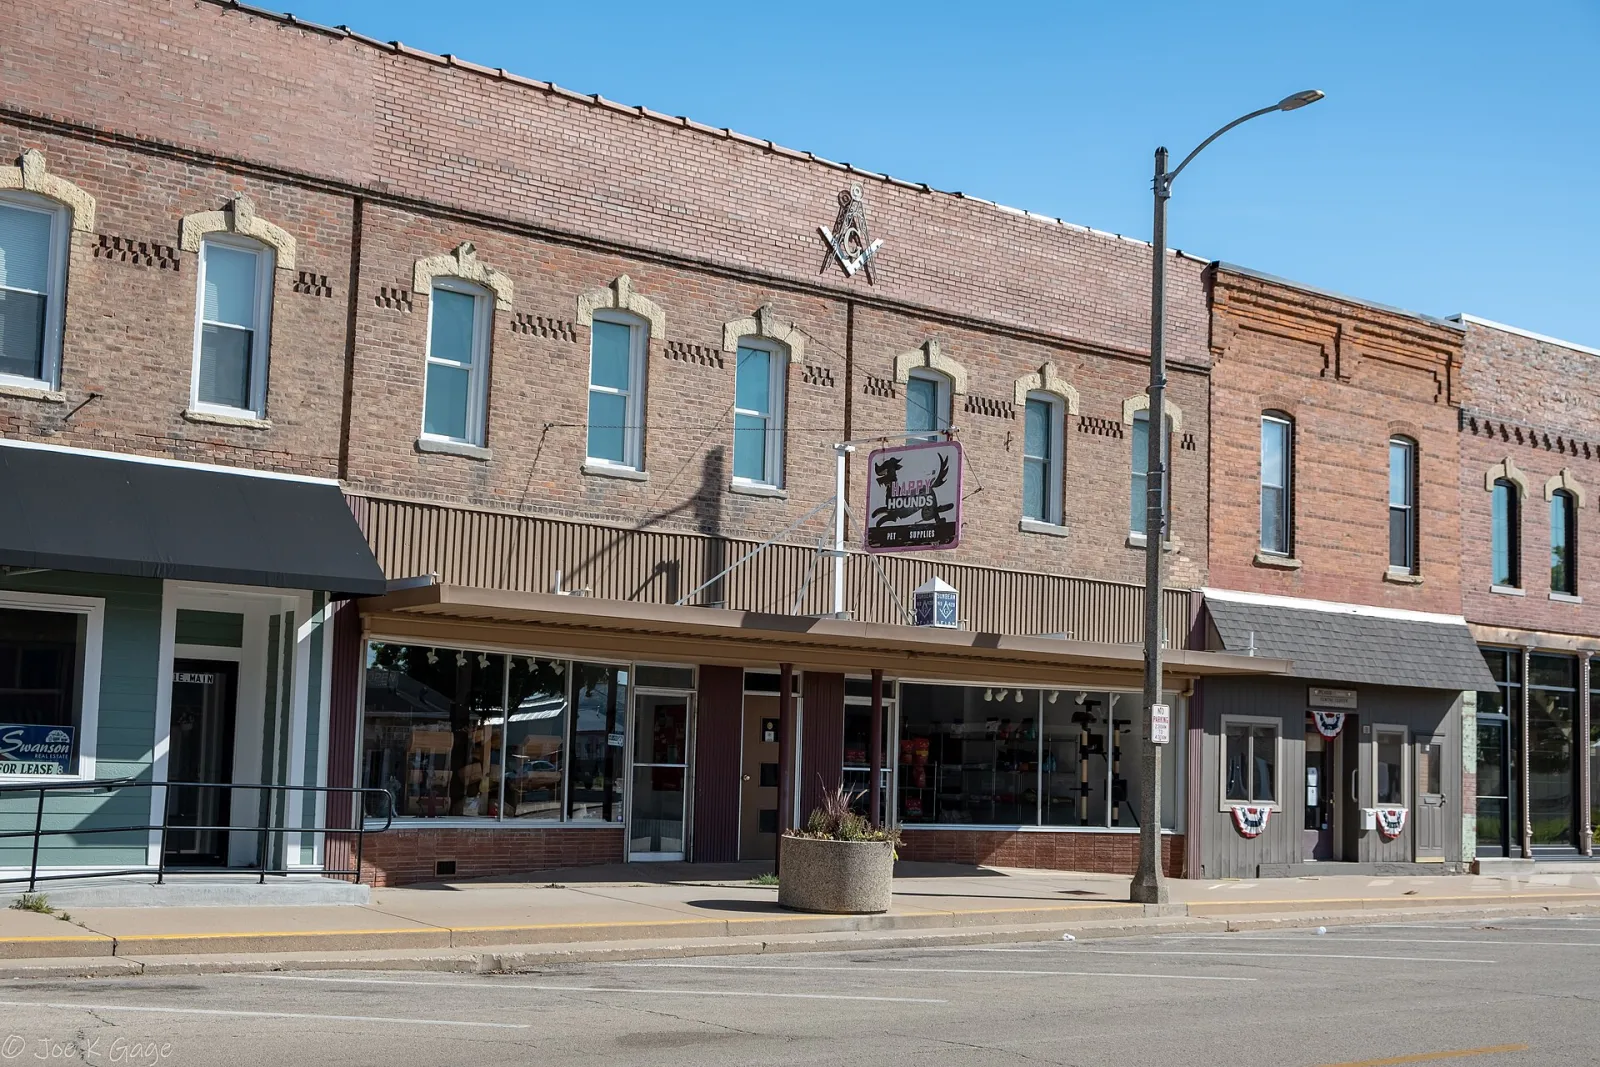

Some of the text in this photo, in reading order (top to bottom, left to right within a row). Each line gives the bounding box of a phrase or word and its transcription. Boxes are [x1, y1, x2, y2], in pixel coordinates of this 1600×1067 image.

[891, 479, 932, 497] HAPPY
[888, 495, 933, 509] HOUNDS
[886, 529, 935, 540] PET SUPPLIES
[1157, 707, 1165, 716] NO
[1152, 716, 1169, 724] PARKING
[0, 729, 70, 754] Swanson
[20, 763, 54, 775] LEASE
